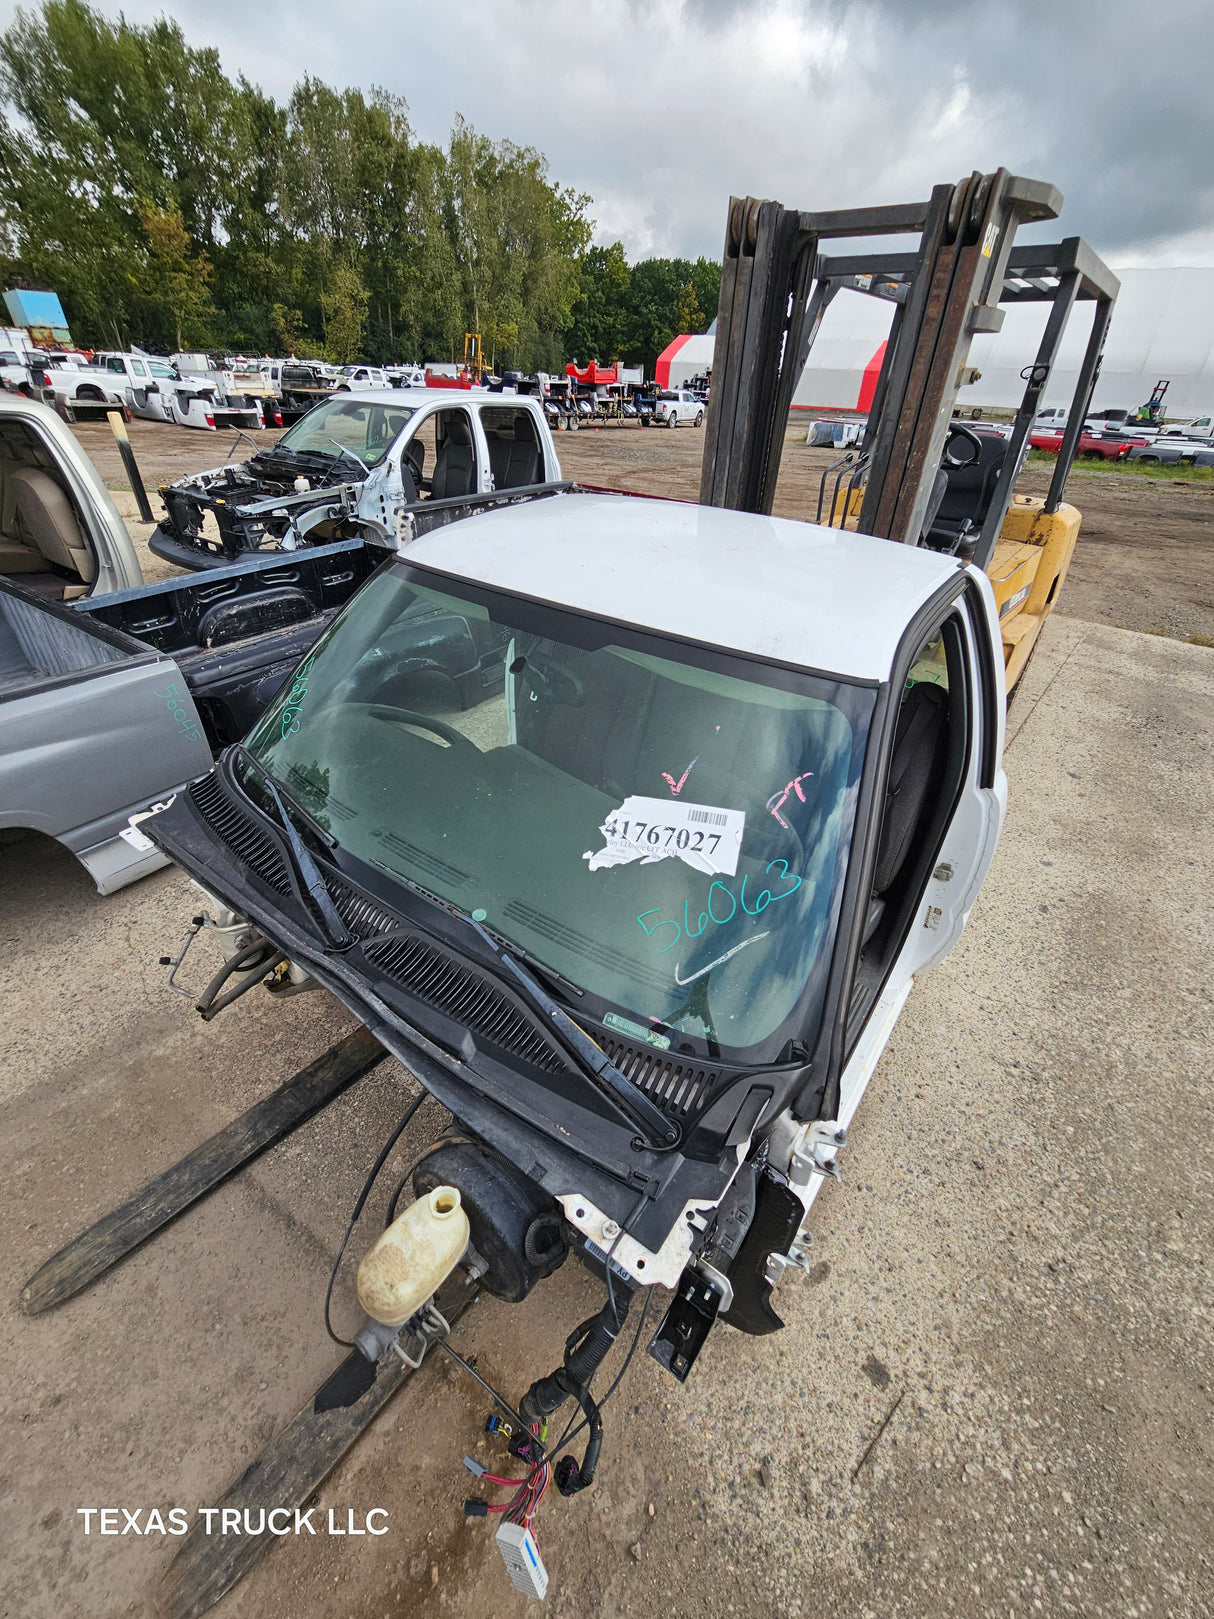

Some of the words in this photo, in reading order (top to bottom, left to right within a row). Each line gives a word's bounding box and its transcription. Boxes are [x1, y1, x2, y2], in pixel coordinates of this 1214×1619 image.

[281, 656, 315, 741] 56063
[605, 819, 722, 855] 41767027
[636, 859, 802, 953] 56063
